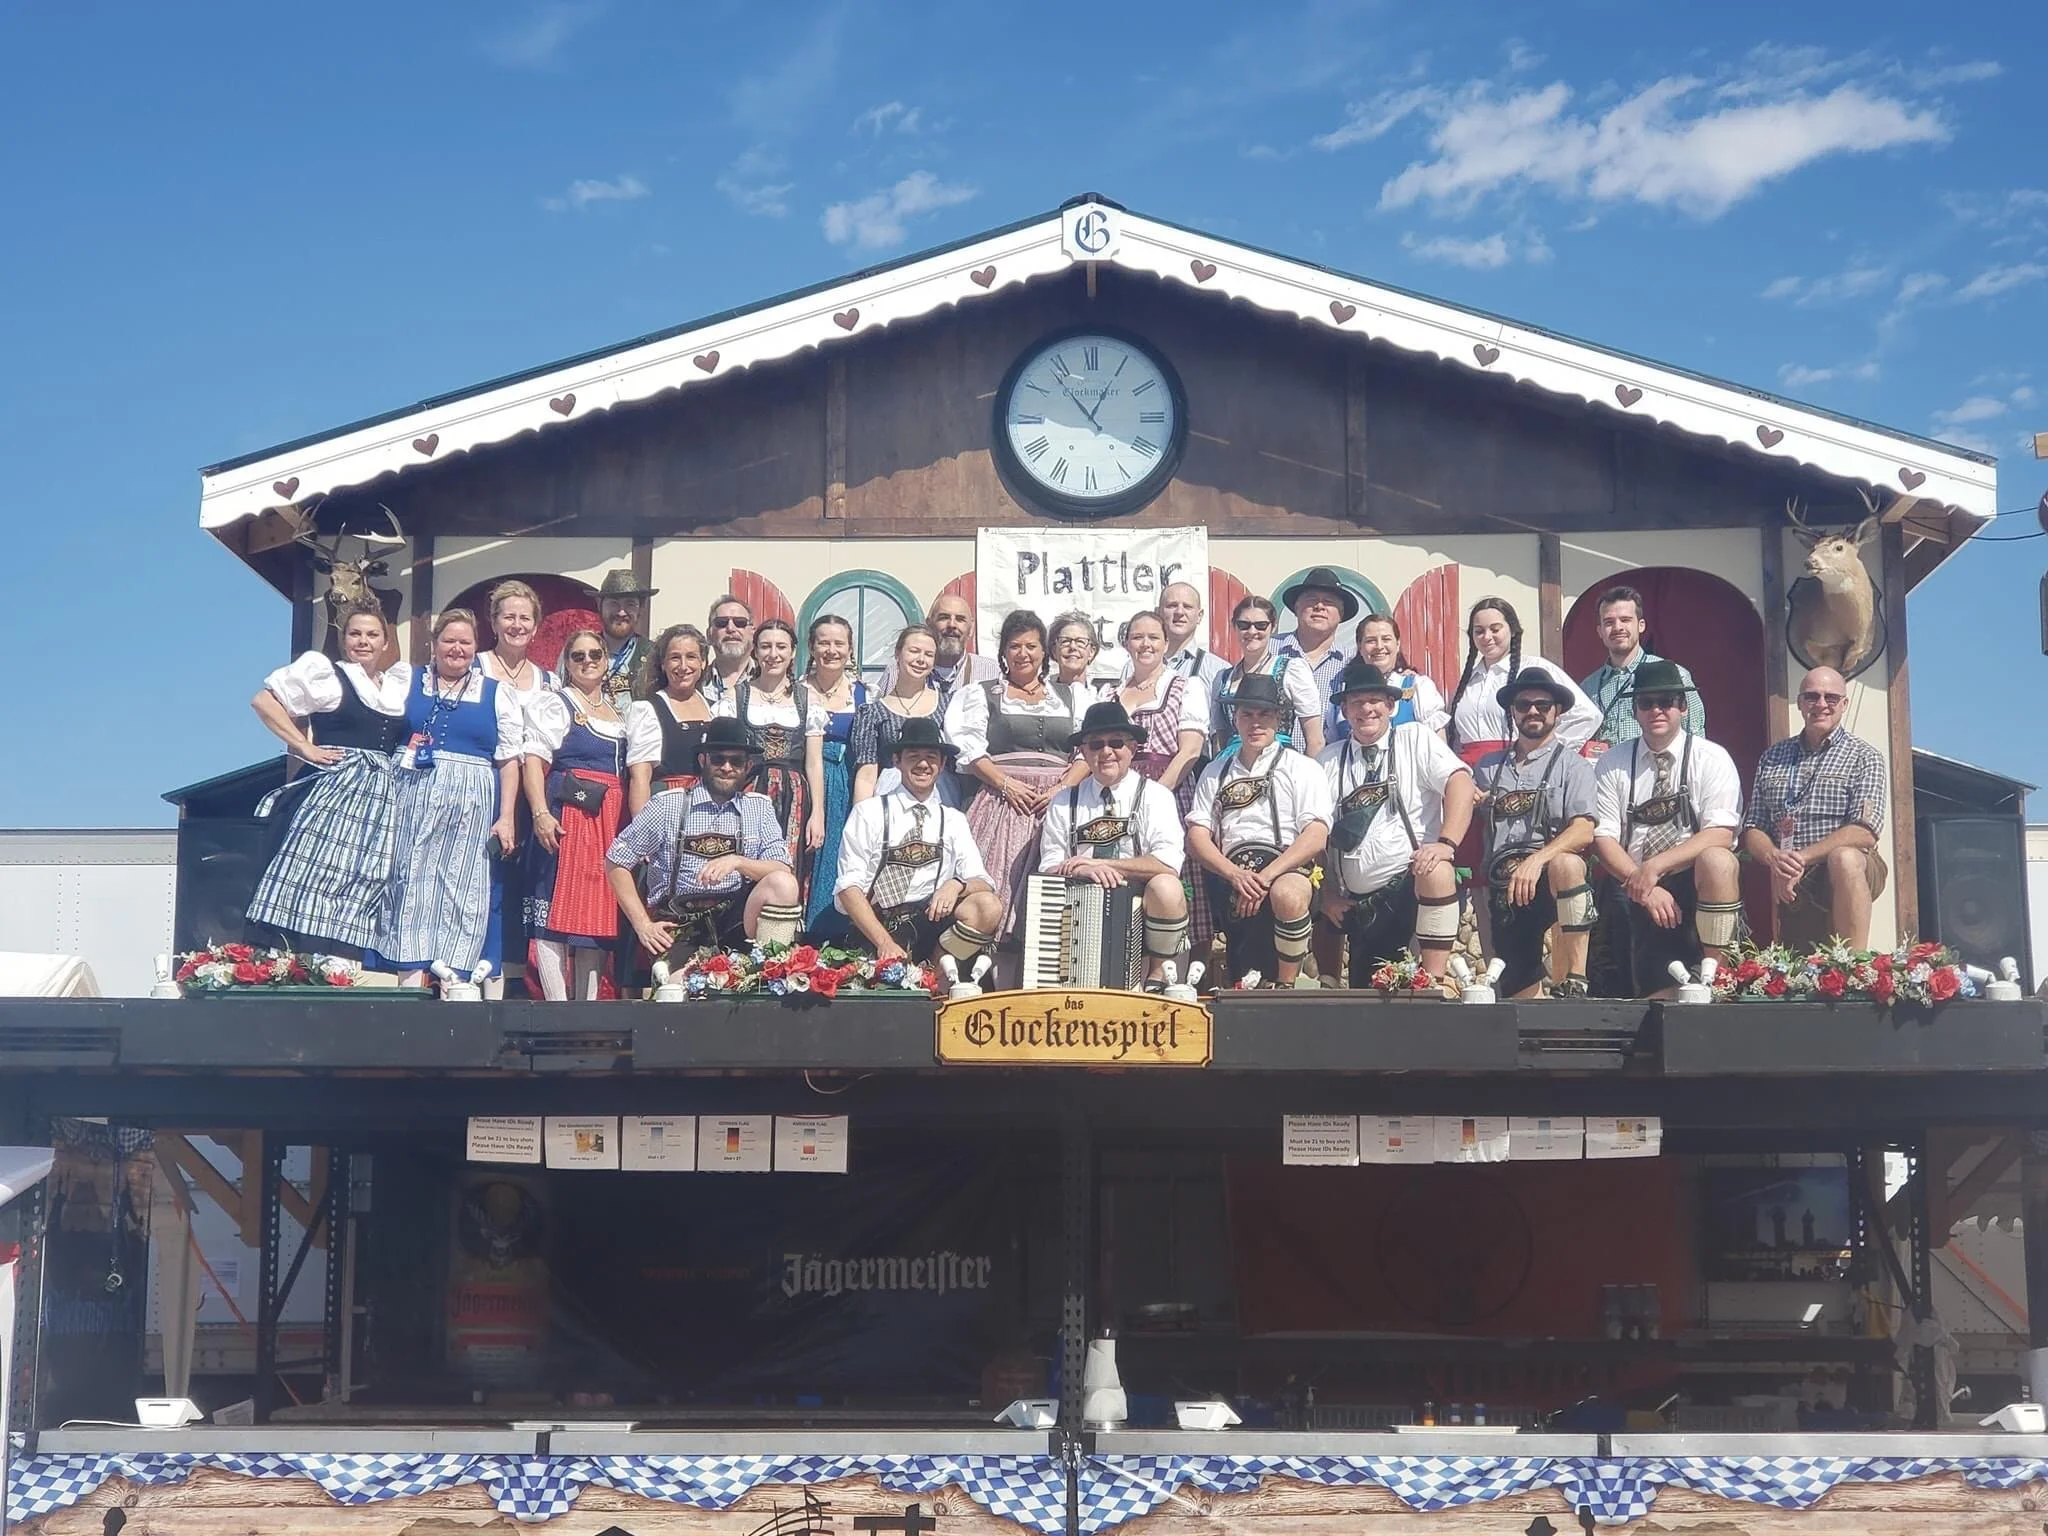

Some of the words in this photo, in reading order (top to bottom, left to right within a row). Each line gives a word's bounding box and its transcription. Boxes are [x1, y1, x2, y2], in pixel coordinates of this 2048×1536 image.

[1075, 210, 1110, 256] G
[1016, 551, 1182, 596] Plattler
[1064, 995, 1084, 1011] das
[964, 1006, 1181, 1060] Glockenspiel
